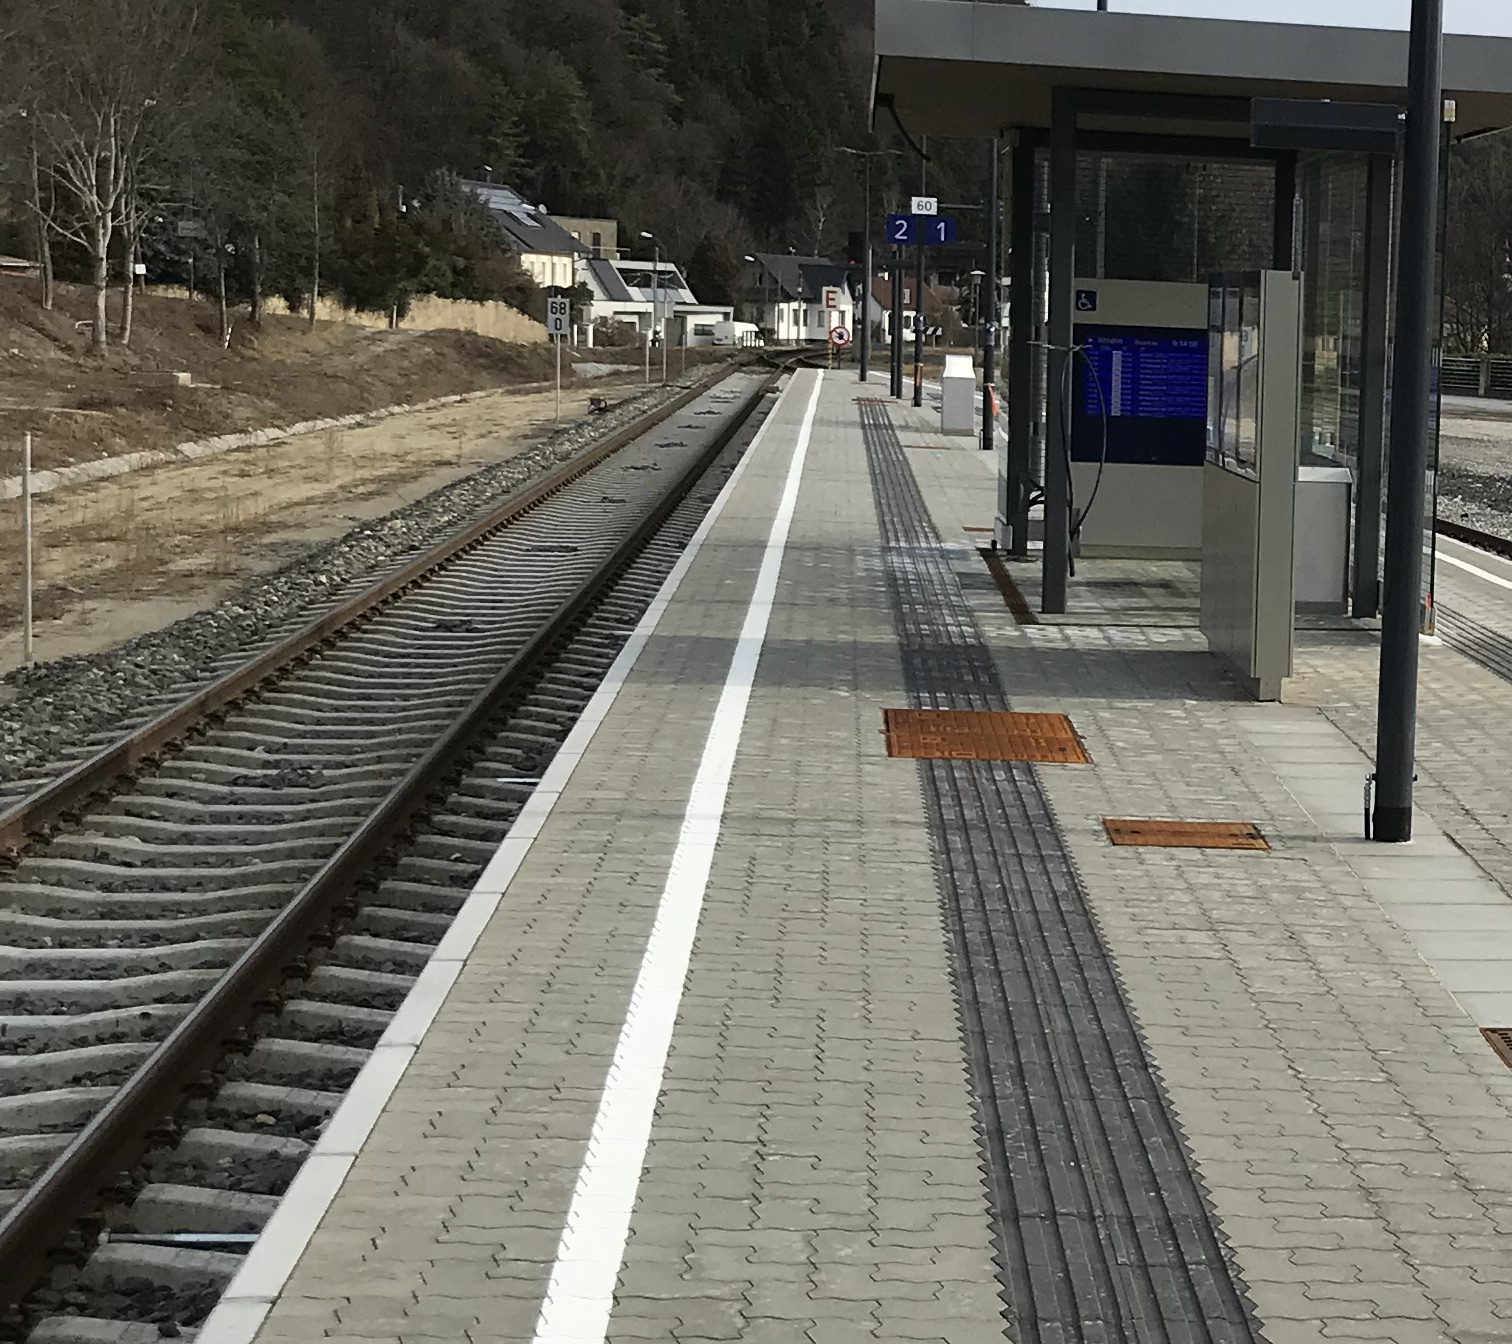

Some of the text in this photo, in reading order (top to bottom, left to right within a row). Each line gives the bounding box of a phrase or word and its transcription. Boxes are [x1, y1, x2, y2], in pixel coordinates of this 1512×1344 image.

[916, 200, 932, 212] 60
[894, 219, 908, 240] 2
[936, 222, 945, 242] 1
[825, 290, 838, 308] E
[550, 301, 567, 316] 68
[554, 317, 563, 331] 0
